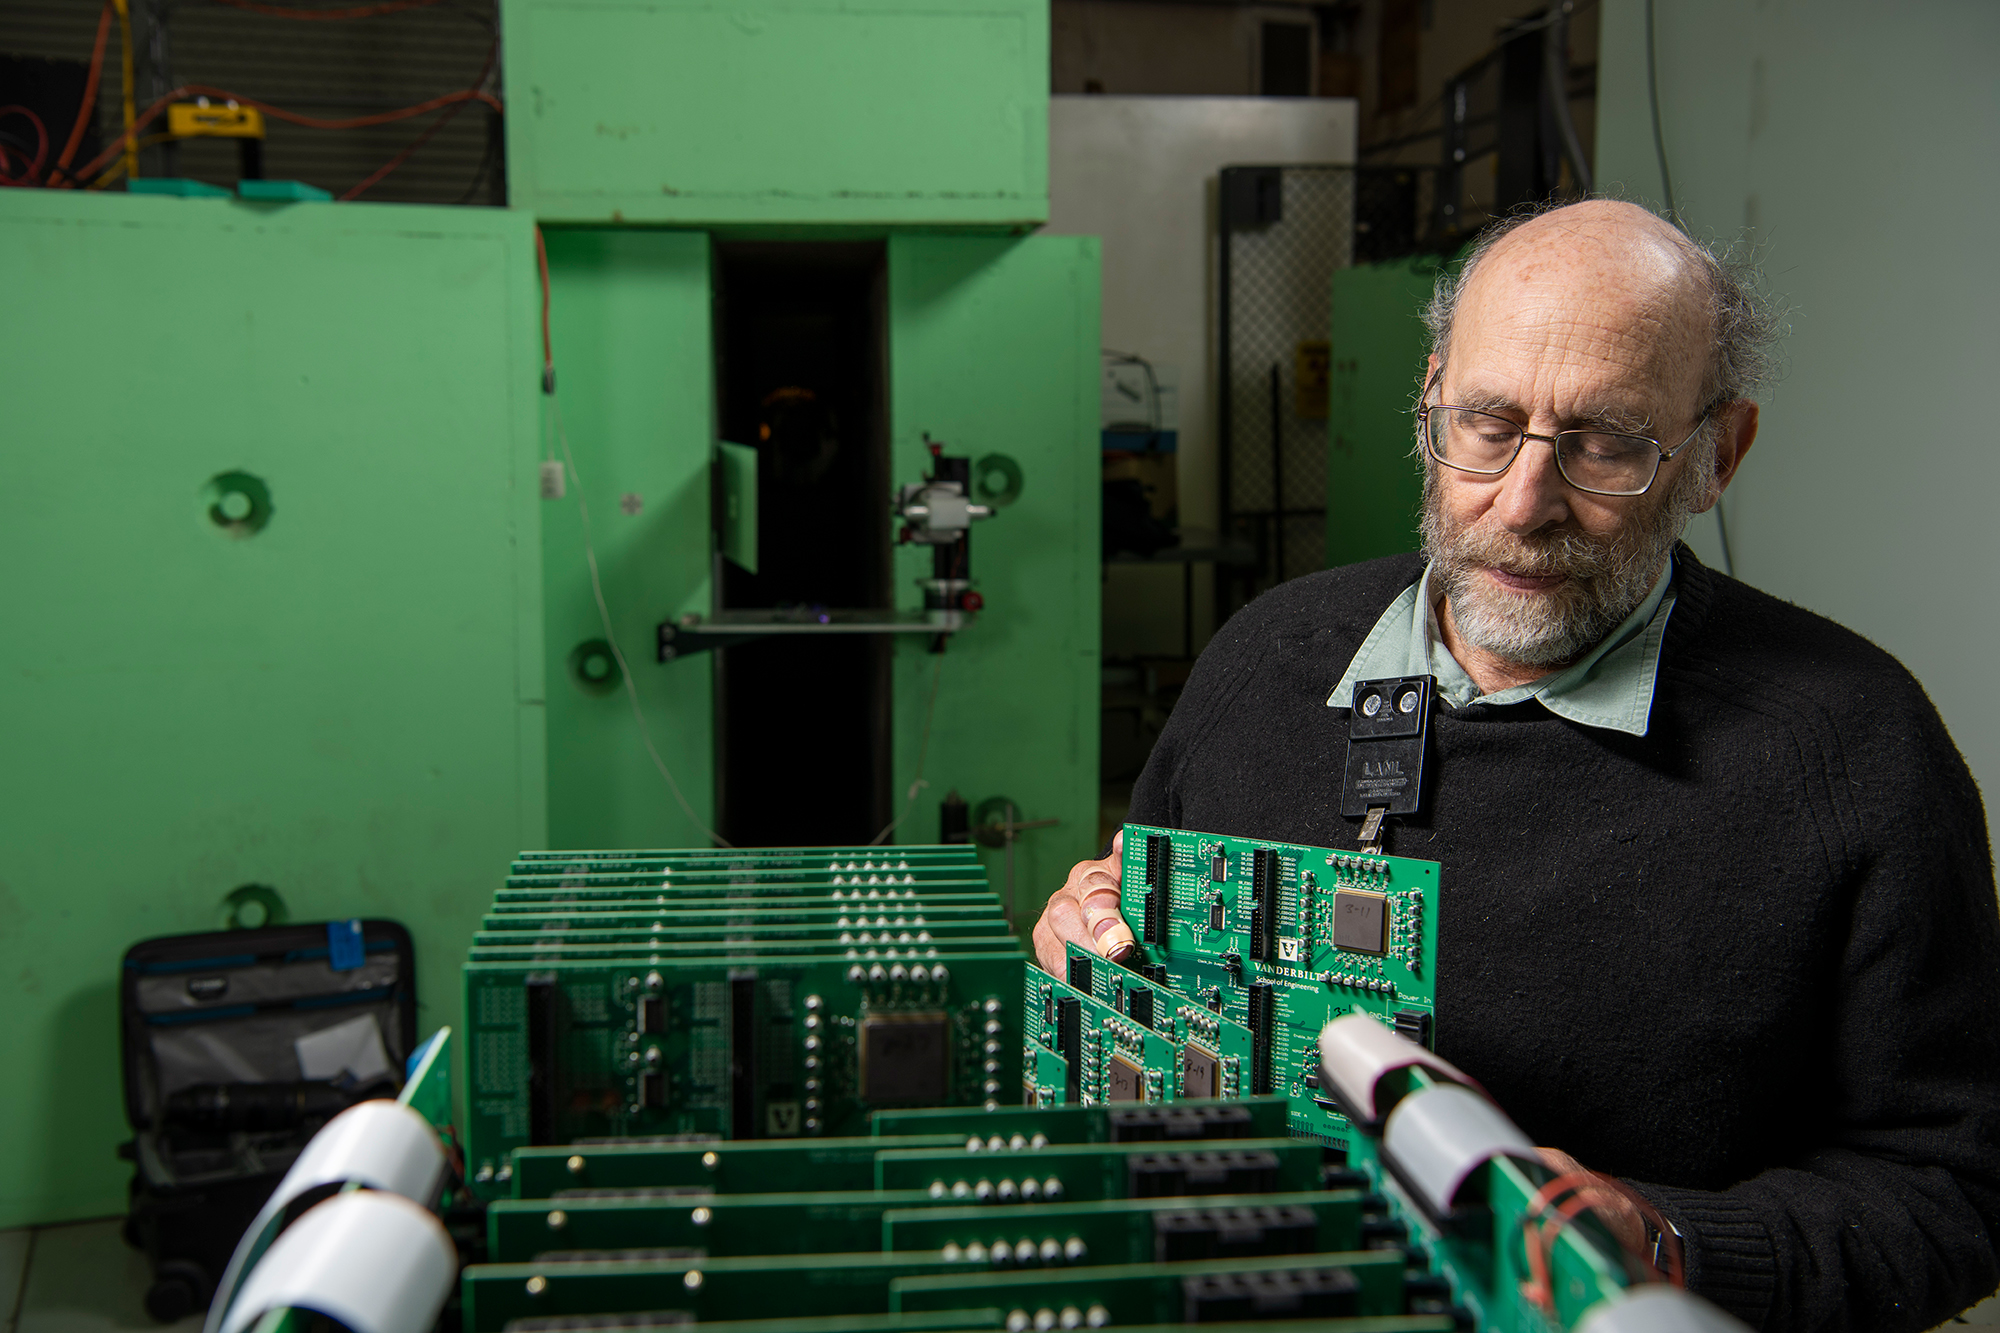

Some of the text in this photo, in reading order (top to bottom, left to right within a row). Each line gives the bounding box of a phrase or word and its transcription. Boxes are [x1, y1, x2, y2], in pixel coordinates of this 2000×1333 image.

[1346, 904, 1370, 918] 3-11
[1254, 962, 1321, 982] VANDERBILT
[1256, 975, 1276, 986] School
[1284, 980, 1320, 994] Engineering
[1398, 992, 1432, 1004] Power In
